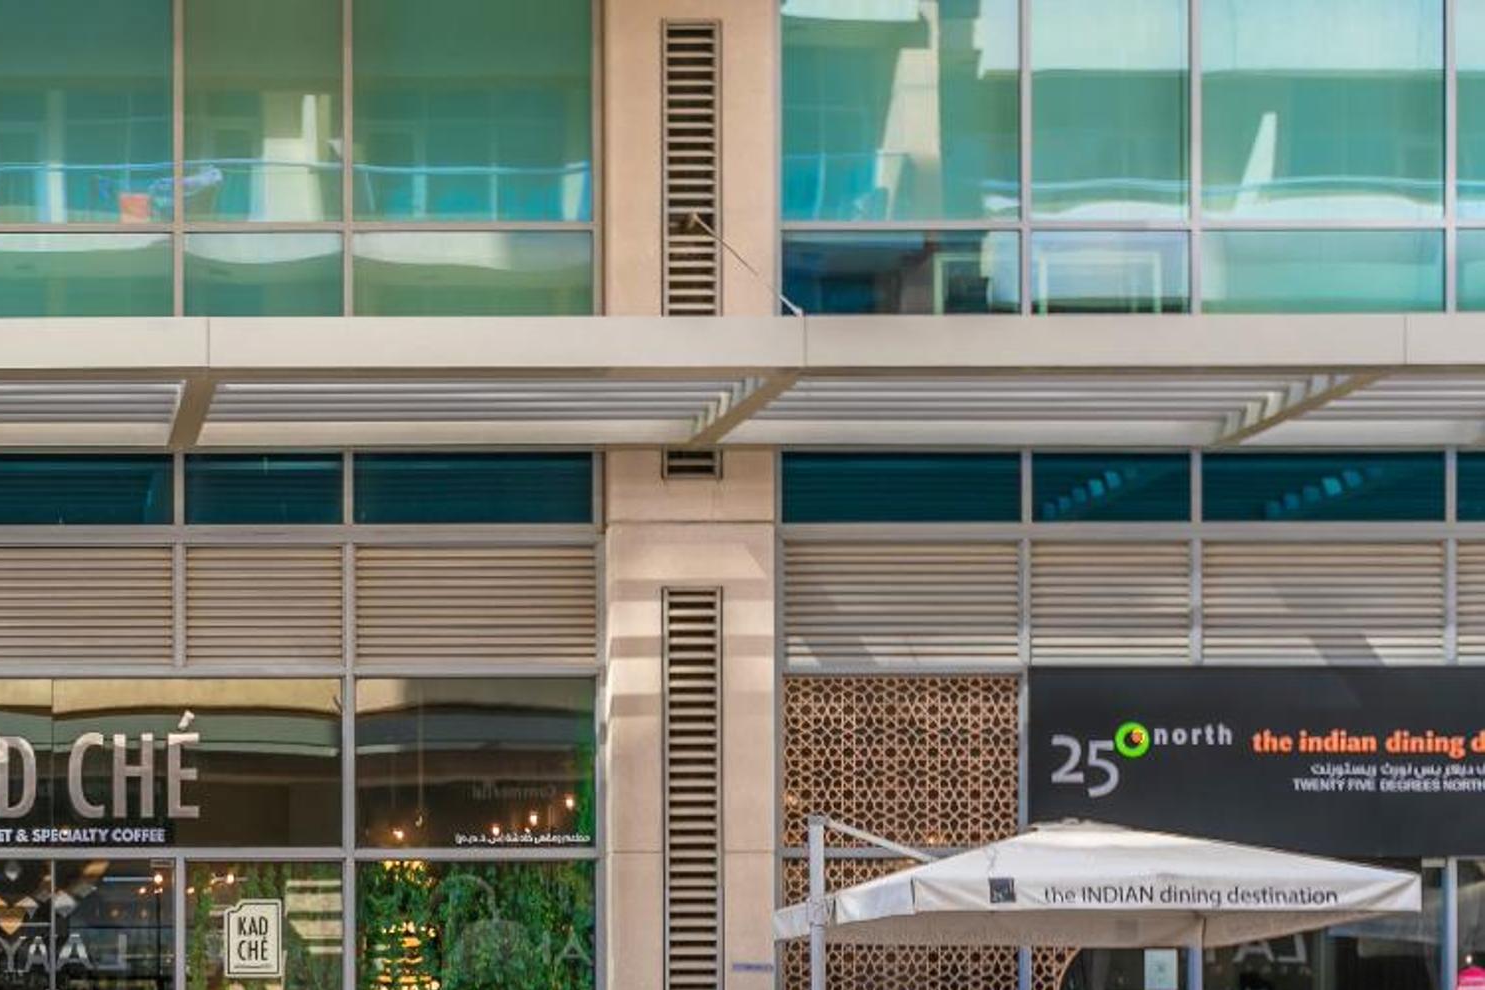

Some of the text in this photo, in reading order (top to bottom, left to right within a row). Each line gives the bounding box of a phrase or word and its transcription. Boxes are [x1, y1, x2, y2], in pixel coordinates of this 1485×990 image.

[1153, 723, 1233, 746] north
[1252, 728, 1294, 753] the
[1299, 729, 1377, 753] indian
[1385, 729, 1466, 759] dining
[68, 710, 201, 819] CHÉ
[1293, 778, 1345, 792] TWENTY
[1347, 778, 1375, 792] FIVE
[1379, 778, 1441, 792] DEGREES
[16, 829, 28, 843] &
[32, 829, 109, 843] SPECIALTY
[112, 829, 166, 843] COFFEE
[1044, 885, 1339, 907] the INDIAN dining destination
[238, 916, 268, 936] KAD
